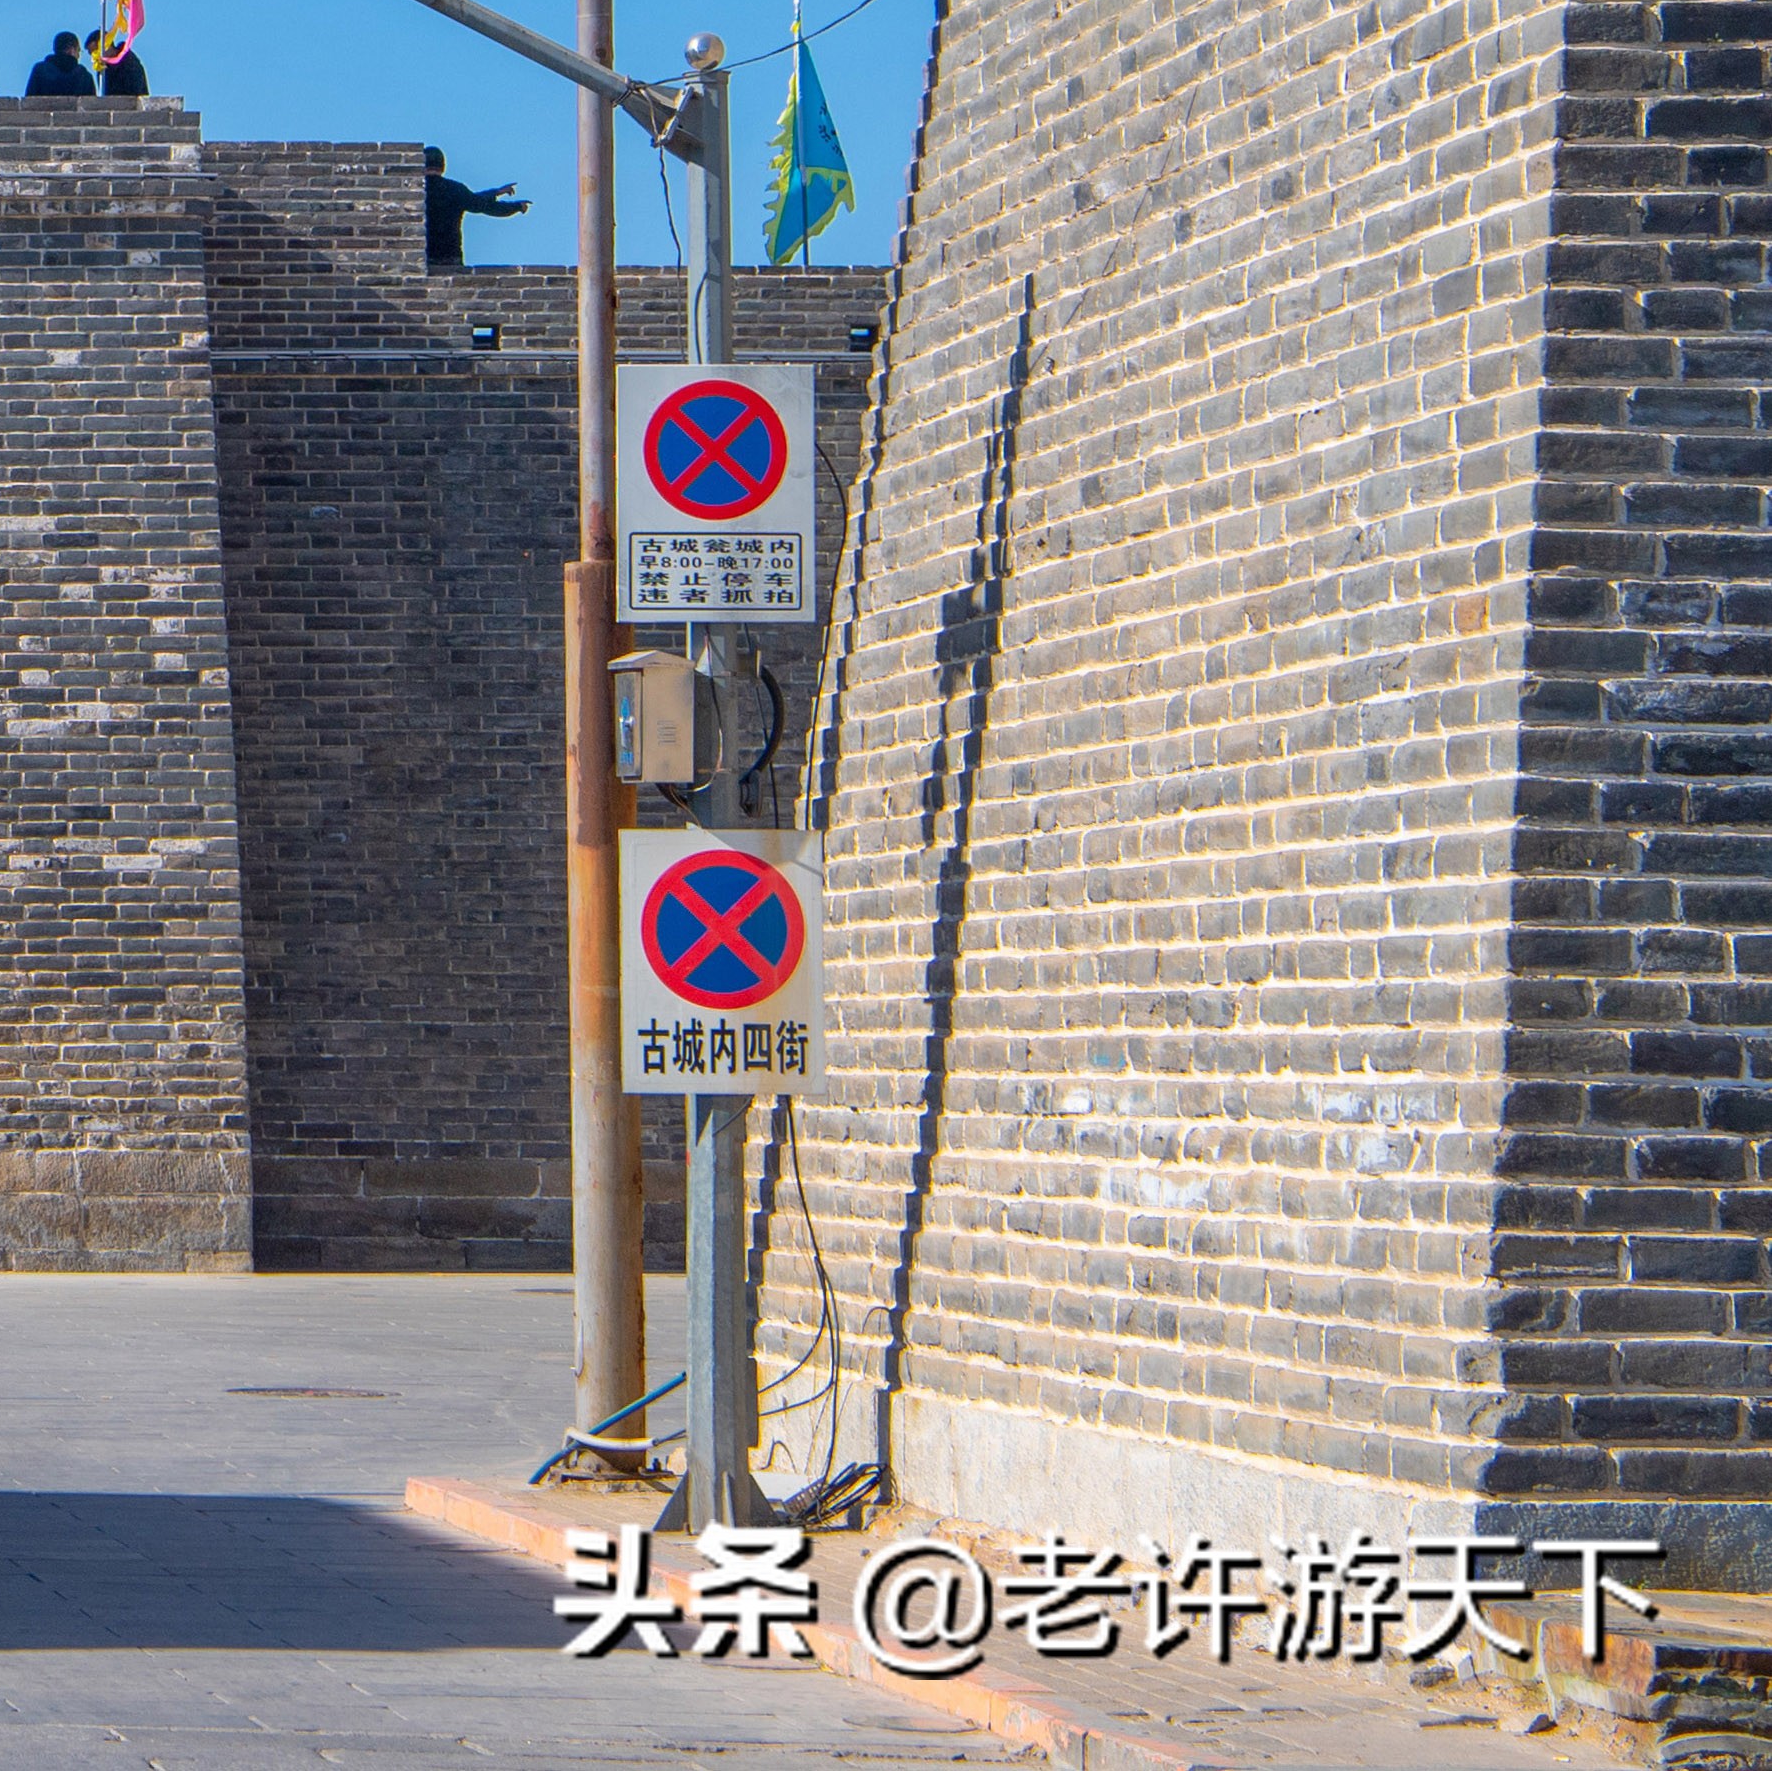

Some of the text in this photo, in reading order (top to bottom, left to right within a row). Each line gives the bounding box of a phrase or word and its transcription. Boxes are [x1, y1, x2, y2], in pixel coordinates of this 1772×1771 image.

[638, 538, 794, 553] 古城瓮城内
[638, 572, 794, 586] 禁止停车
[638, 588, 794, 603] 违者抓拍
[637, 1018, 808, 1075] 古城内四街
